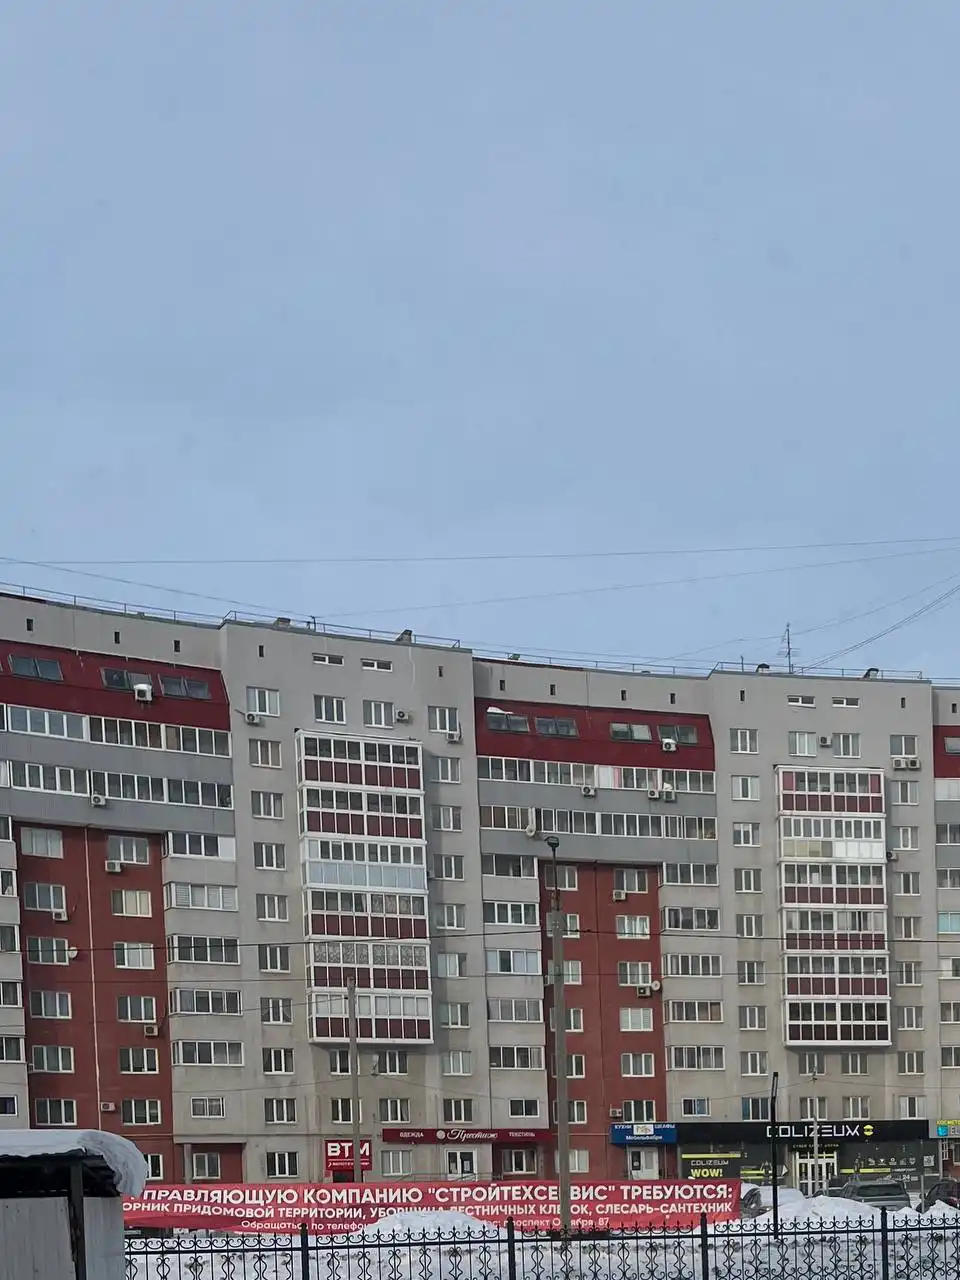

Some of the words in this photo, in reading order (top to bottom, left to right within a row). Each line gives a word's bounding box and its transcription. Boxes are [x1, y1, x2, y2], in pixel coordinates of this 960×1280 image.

[446, 1128, 498, 1142] Престиж
[690, 1168, 723, 1178] WOW!
[131, 1188, 298, 1206] ПРАВЛЯЮЩУЮ
[303, 1187, 423, 1204] КОМПАНИЮ
[428, 1184, 616, 1203] "СТРОЙТЕХСЕВИС"
[620, 1184, 733, 1201] ТРЕБУЮТСЯ:
[123, 1202, 170, 1213] ОРНИК
[173, 1202, 275, 1218] ПРИДОМОВОЙ
[278, 1207, 366, 1220] ТЕРРИТОРИИ,
[539, 1203, 593, 1216] КЛЕОК,
[595, 1201, 733, 1215] СЛЕСАРЬ-САНТЕХНИК
[241, 1220, 308, 1230] Обращатьс
[311, 1221, 325, 1230] по
[503, 1218, 550, 1227] поспект
[598, 1217, 609, 1227] 87
